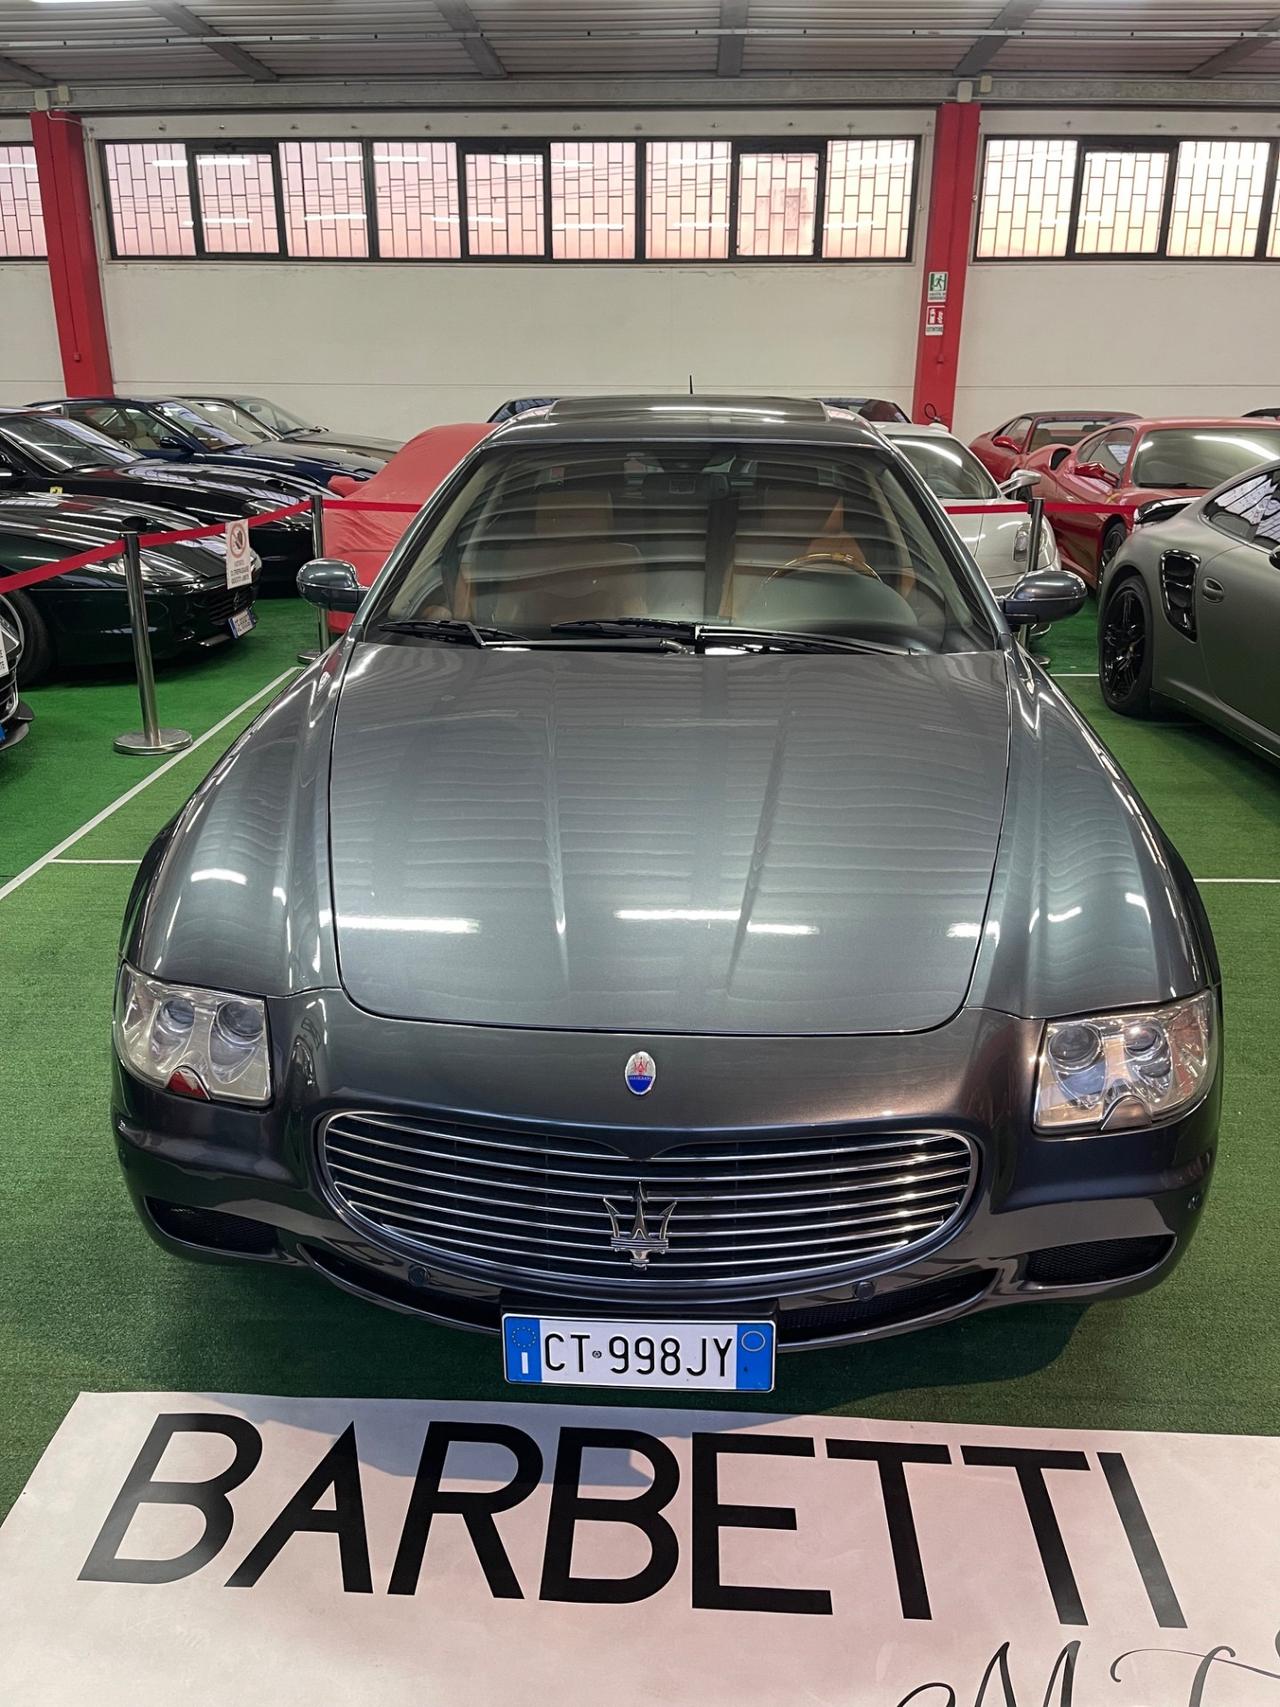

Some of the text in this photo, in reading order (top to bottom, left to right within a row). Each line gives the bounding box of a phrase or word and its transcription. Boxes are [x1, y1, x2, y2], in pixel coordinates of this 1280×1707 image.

[544, 1332, 591, 1373] CT
[608, 1336, 733, 1377] 998JY
[77, 1412, 1189, 1629] BARBETTI
